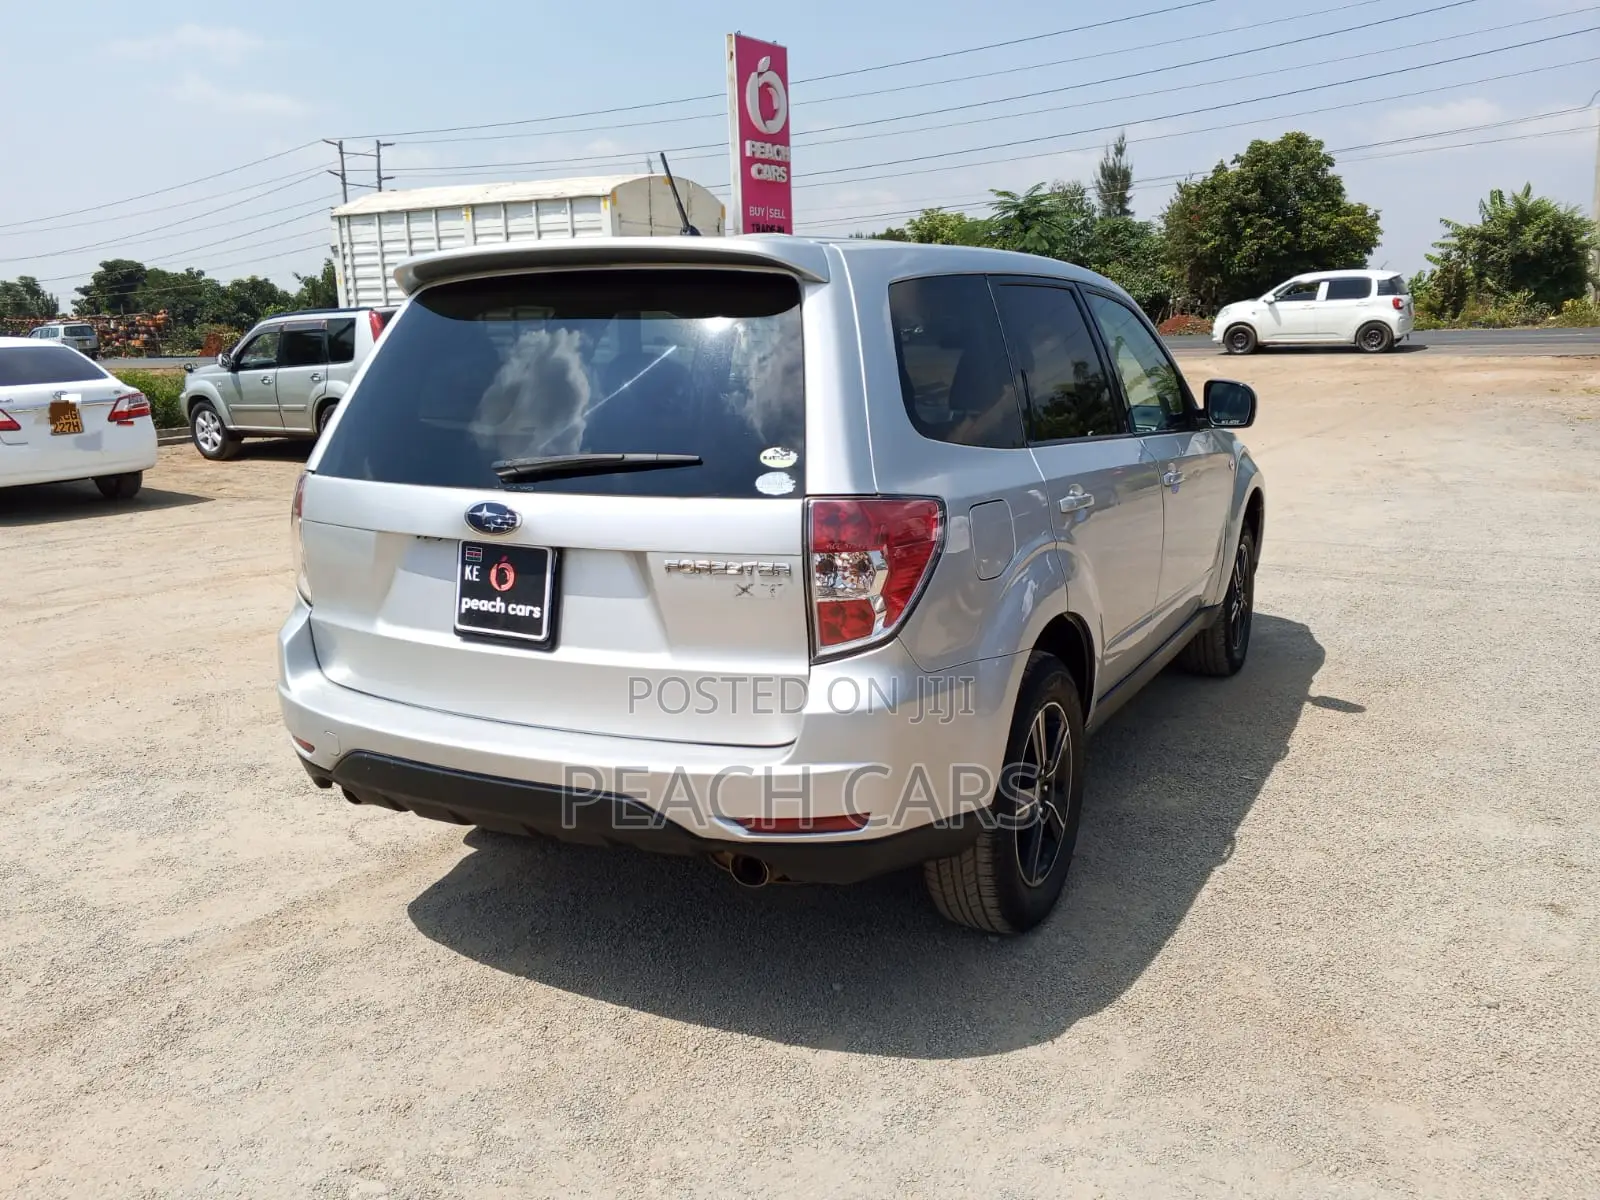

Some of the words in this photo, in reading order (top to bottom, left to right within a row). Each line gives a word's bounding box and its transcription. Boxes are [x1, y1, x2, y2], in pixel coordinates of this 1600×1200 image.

[745, 140, 790, 161] PEACH
[751, 163, 787, 182] CARS
[749, 206, 765, 217] BUY
[769, 208, 785, 219] SELL
[464, 564, 480, 581] KE
[461, 597, 505, 613] peach
[508, 604, 541, 618] cars
